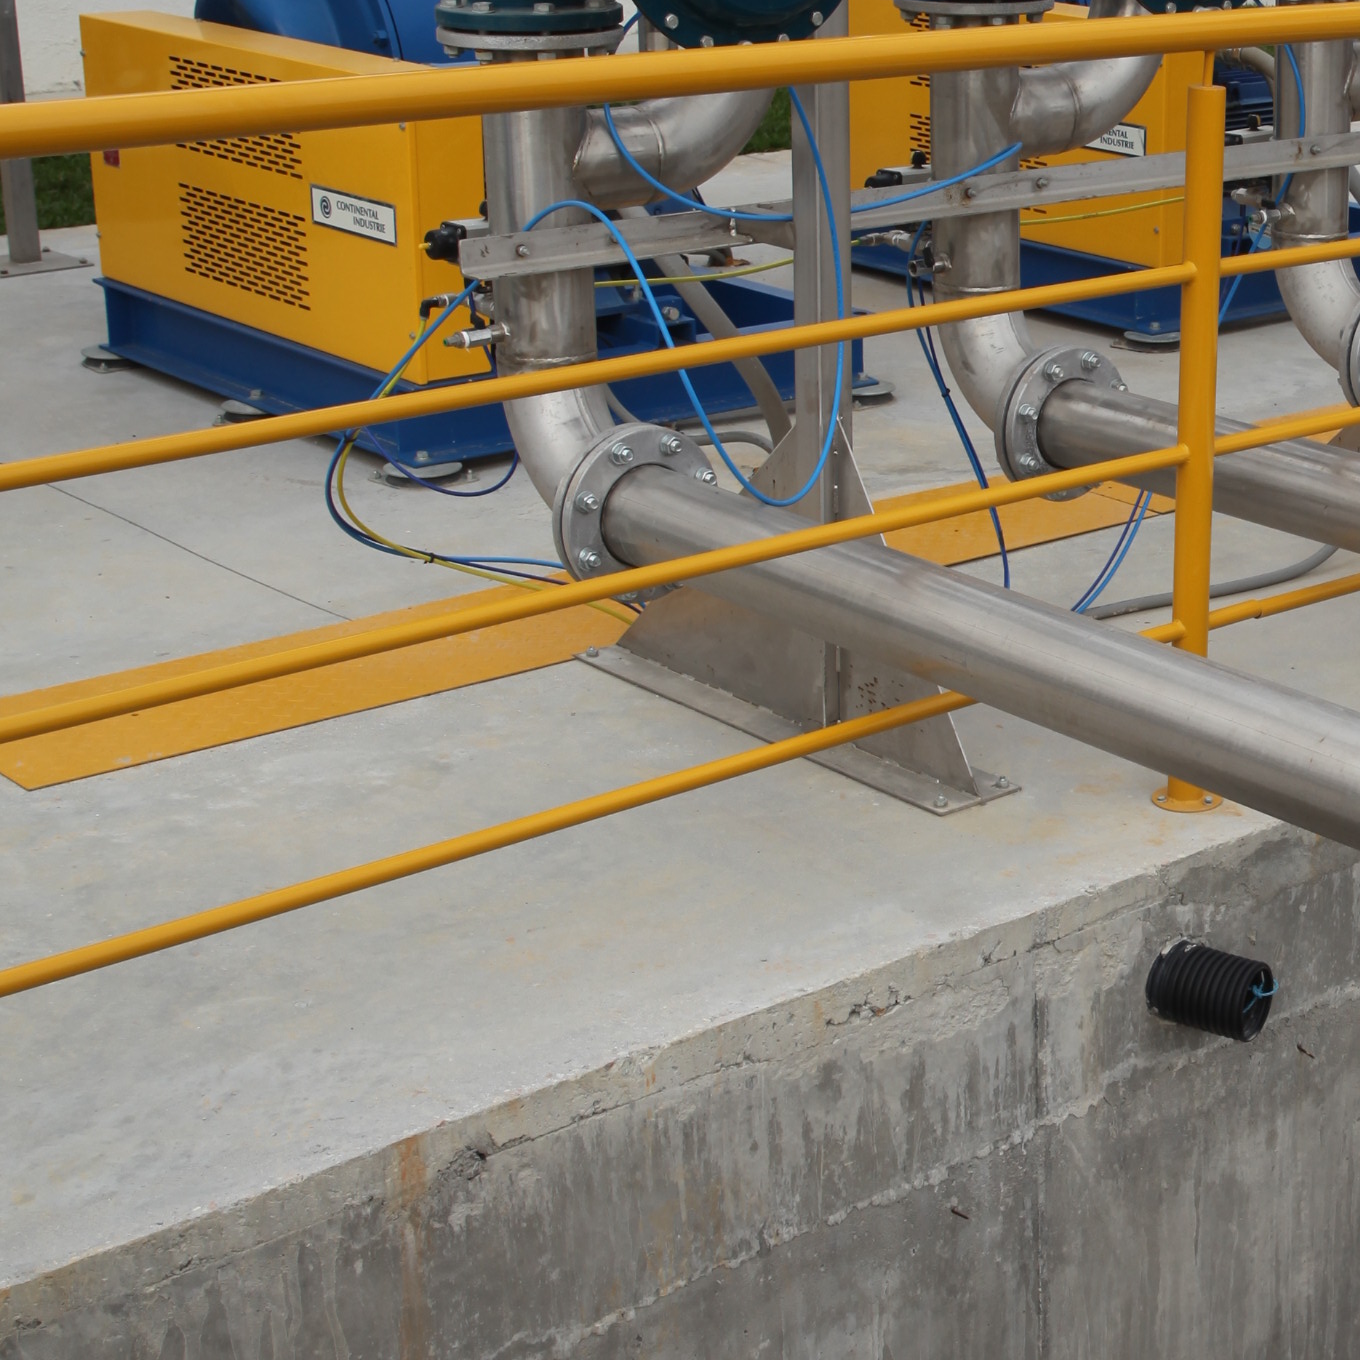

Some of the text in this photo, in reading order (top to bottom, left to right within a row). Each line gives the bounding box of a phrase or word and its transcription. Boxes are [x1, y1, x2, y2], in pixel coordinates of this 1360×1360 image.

[1100, 136, 1135, 150] INDUSTRIE
[336, 200, 379, 220] CONTINENTAL
[353, 216, 386, 233] INDUSTRIE
